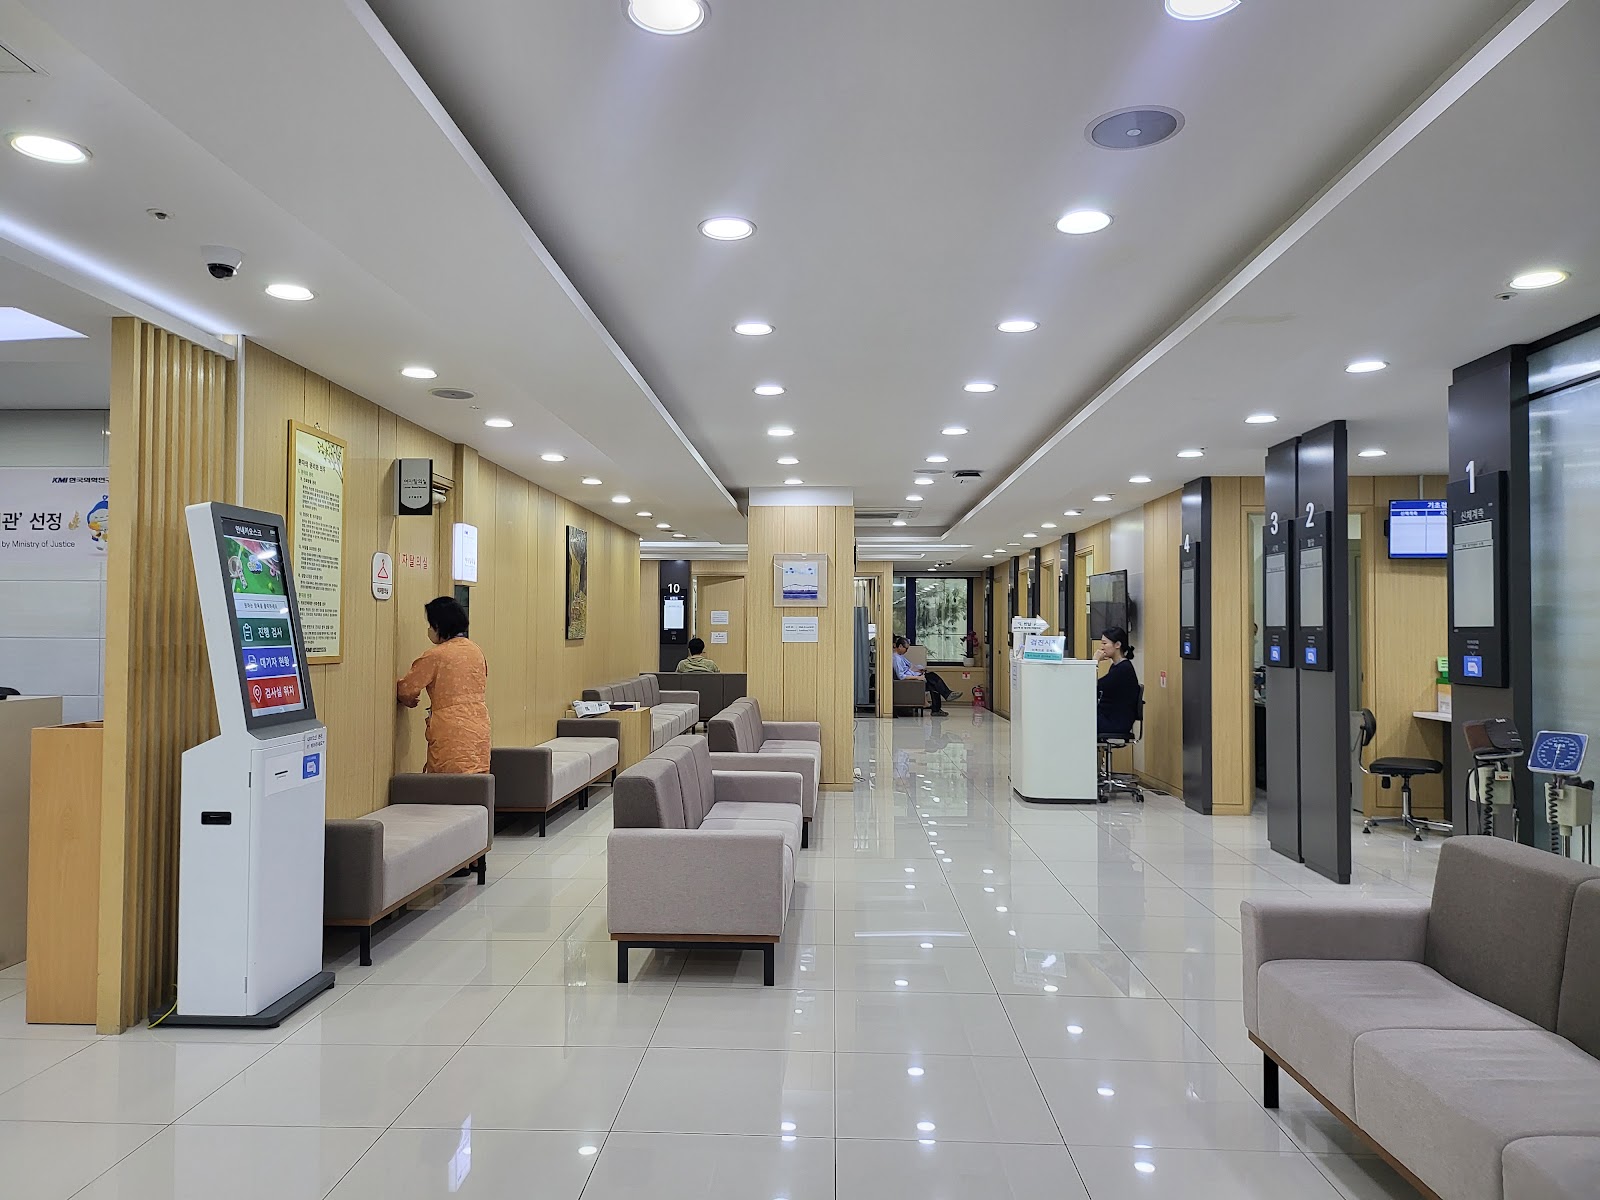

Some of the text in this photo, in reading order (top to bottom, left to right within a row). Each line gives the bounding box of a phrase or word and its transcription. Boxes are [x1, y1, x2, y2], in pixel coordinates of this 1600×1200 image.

[1465, 461, 1475, 493] 1
[30, 512, 62, 531] 선정
[1305, 502, 1315, 528] 2
[1461, 508, 1484, 521] 신체계측
[1270, 511, 1279, 535] 3
[2, 540, 75, 549] by Ministry of Justice
[1183, 533, 1190, 553] 4
[667, 583, 680, 593] 10
[258, 626, 283, 638] 진행 검사
[260, 655, 290, 669] 대기자 현황
[265, 684, 295, 699] 검사실 위치
